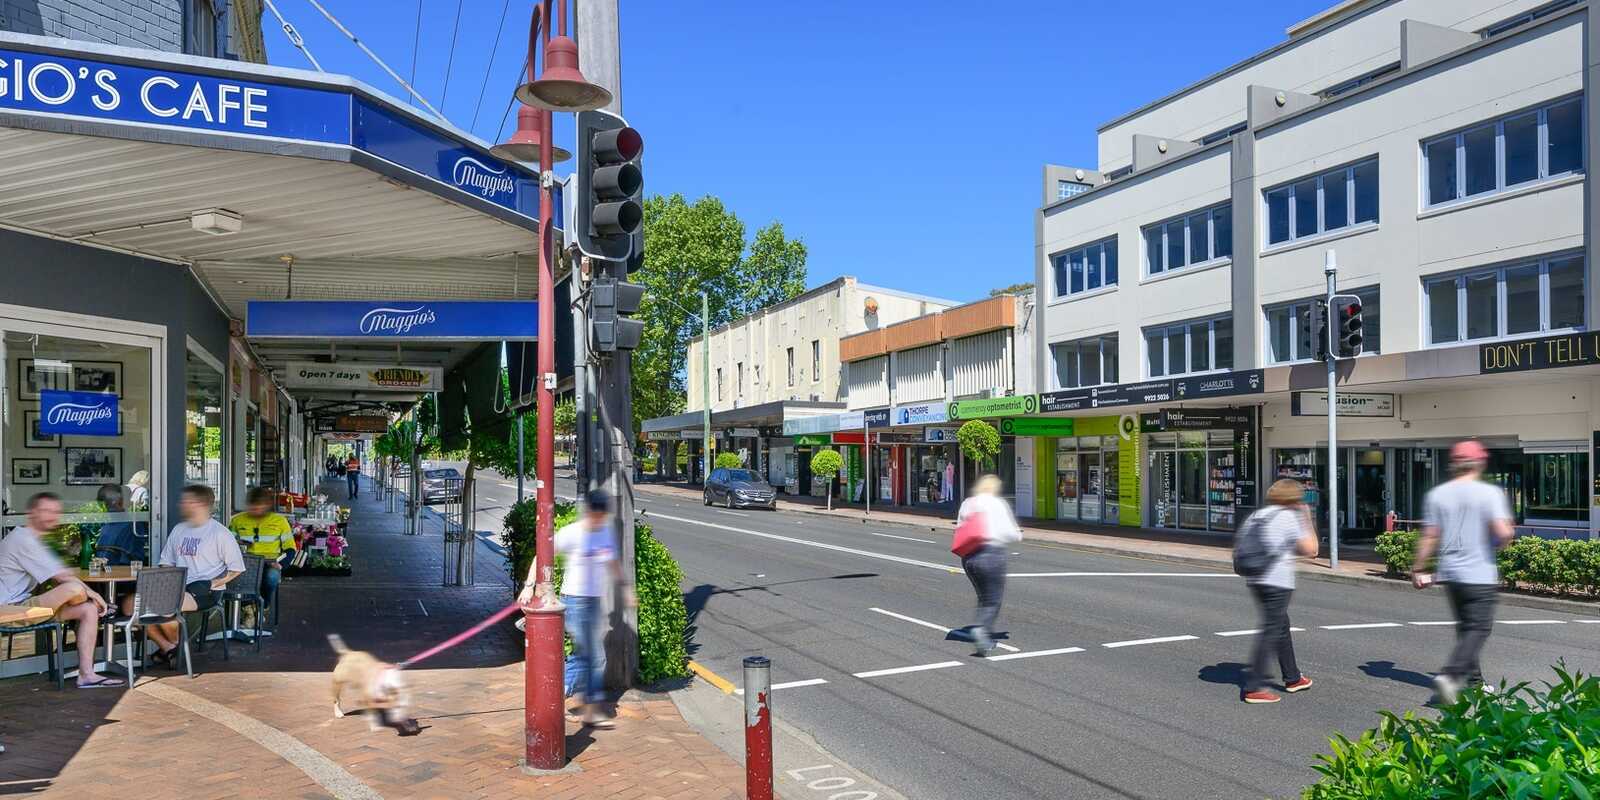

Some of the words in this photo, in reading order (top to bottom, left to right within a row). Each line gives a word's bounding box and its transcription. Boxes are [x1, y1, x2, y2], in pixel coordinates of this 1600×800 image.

[0, 59, 121, 111] IO'S
[140, 76, 268, 129] CAFE
[453, 156, 514, 197] Maggio's
[359, 305, 436, 334] Maggio's
[1485, 342, 1537, 369] DON'T
[1544, 337, 1588, 364] TELL
[299, 370, 327, 379] Open
[328, 370, 335, 378] 7
[336, 371, 361, 380] days
[377, 369, 421, 380] FRIENDLY
[1041, 394, 1056, 405] hair
[909, 406, 929, 415] THORPE
[986, 400, 1022, 412] optometrist
[47, 401, 112, 426] Maggio's
[1167, 411, 1184, 420] hair
